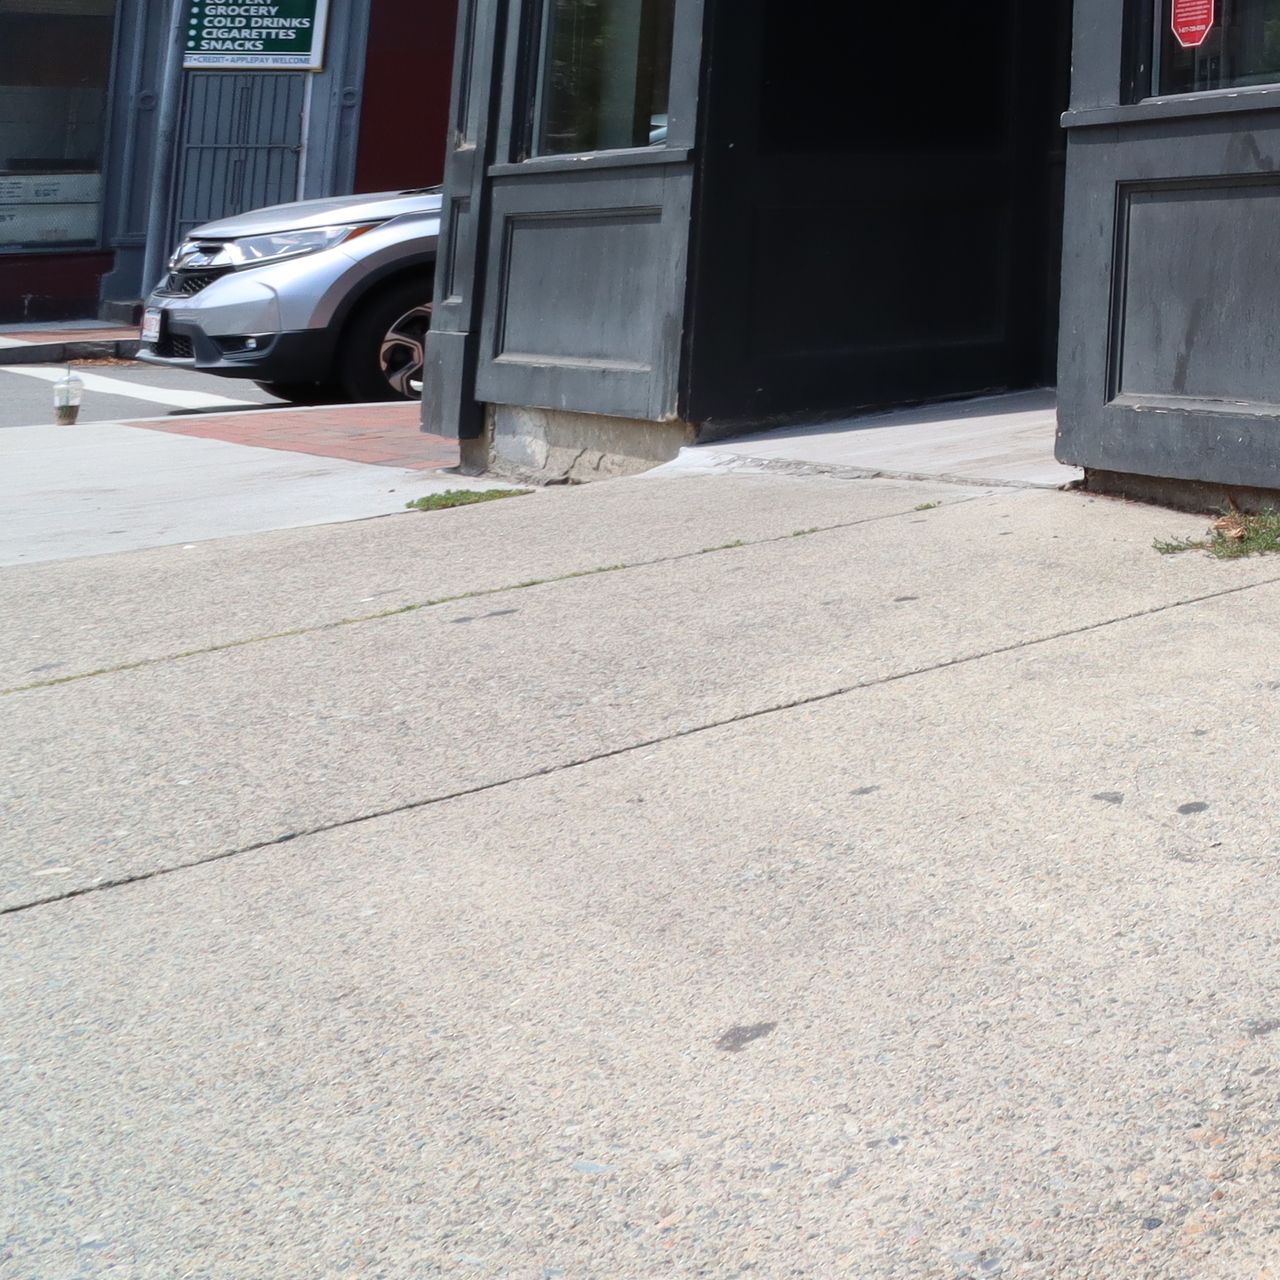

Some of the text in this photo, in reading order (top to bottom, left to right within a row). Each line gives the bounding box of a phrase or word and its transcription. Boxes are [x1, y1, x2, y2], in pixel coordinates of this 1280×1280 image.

[204, 5, 279, 16] GROCERY
[203, 17, 311, 28] COLD DRINKS
[201, 28, 297, 39] CIGARETTES
[200, 40, 264, 50] SNACKS
[272, 56, 310, 65] WELCOME
